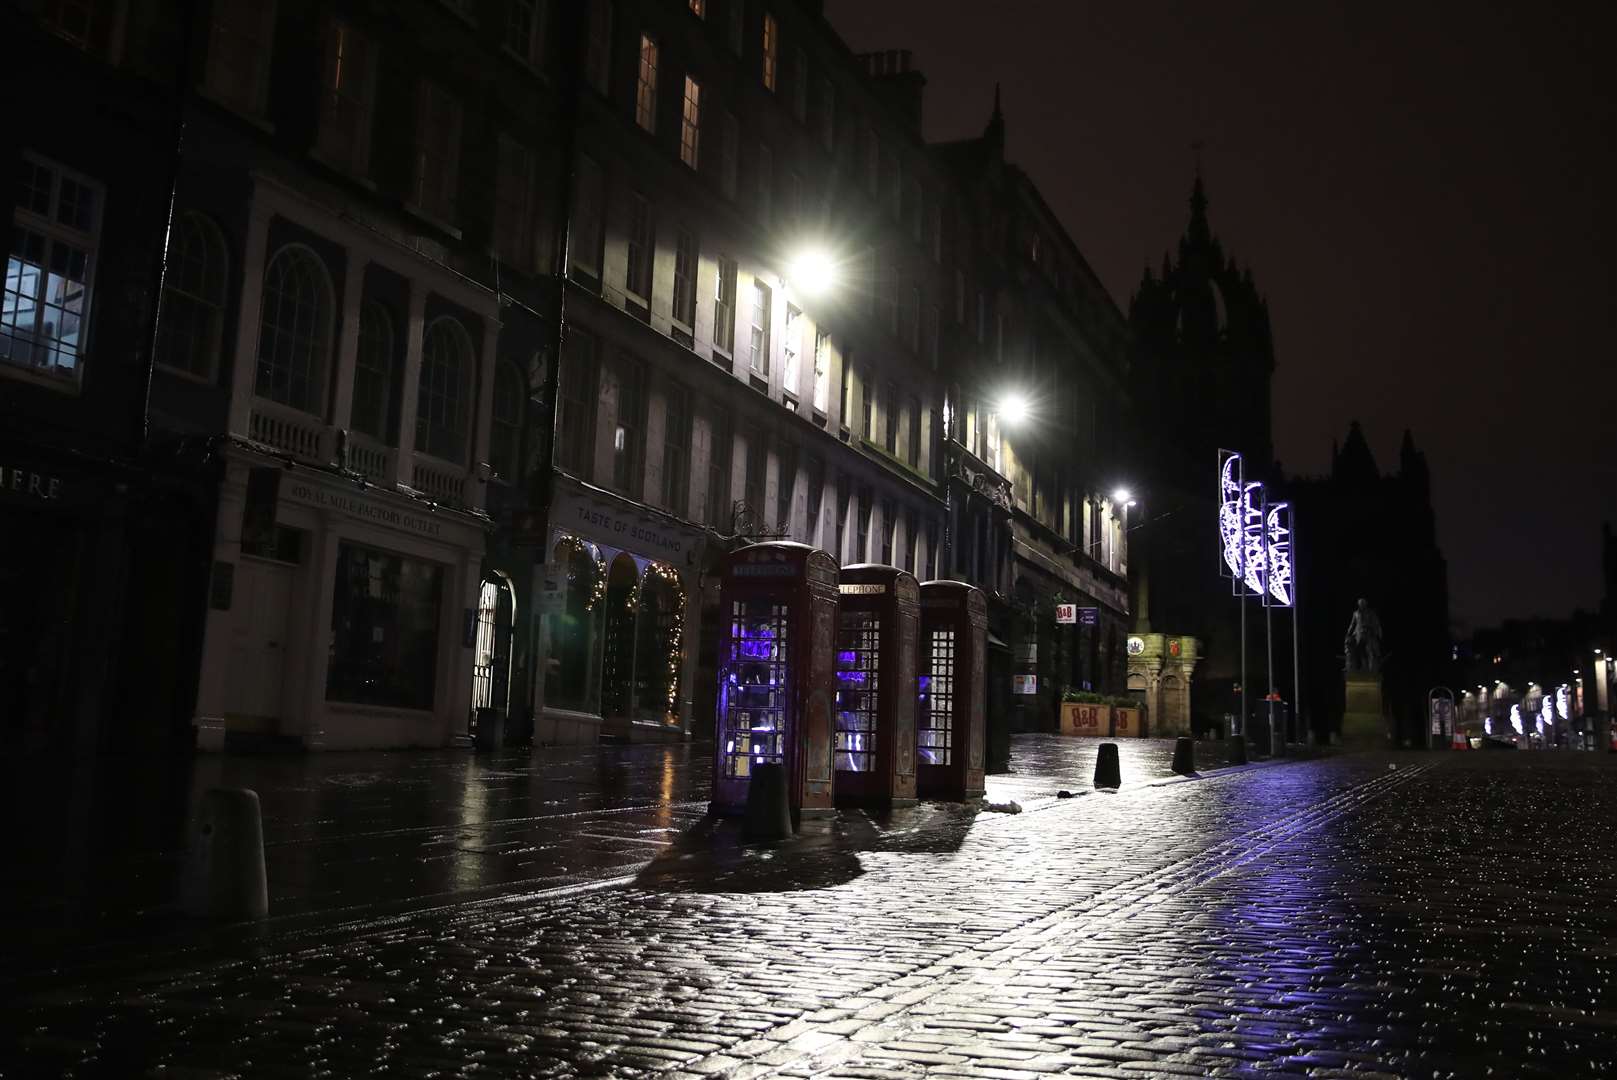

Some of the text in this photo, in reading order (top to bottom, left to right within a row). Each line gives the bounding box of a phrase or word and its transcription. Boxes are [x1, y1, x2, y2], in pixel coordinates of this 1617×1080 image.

[292, 486, 440, 536] ROYAL MILE FACTORY OUTLET
[577, 507, 680, 551] TASTE OF SCOTLAND
